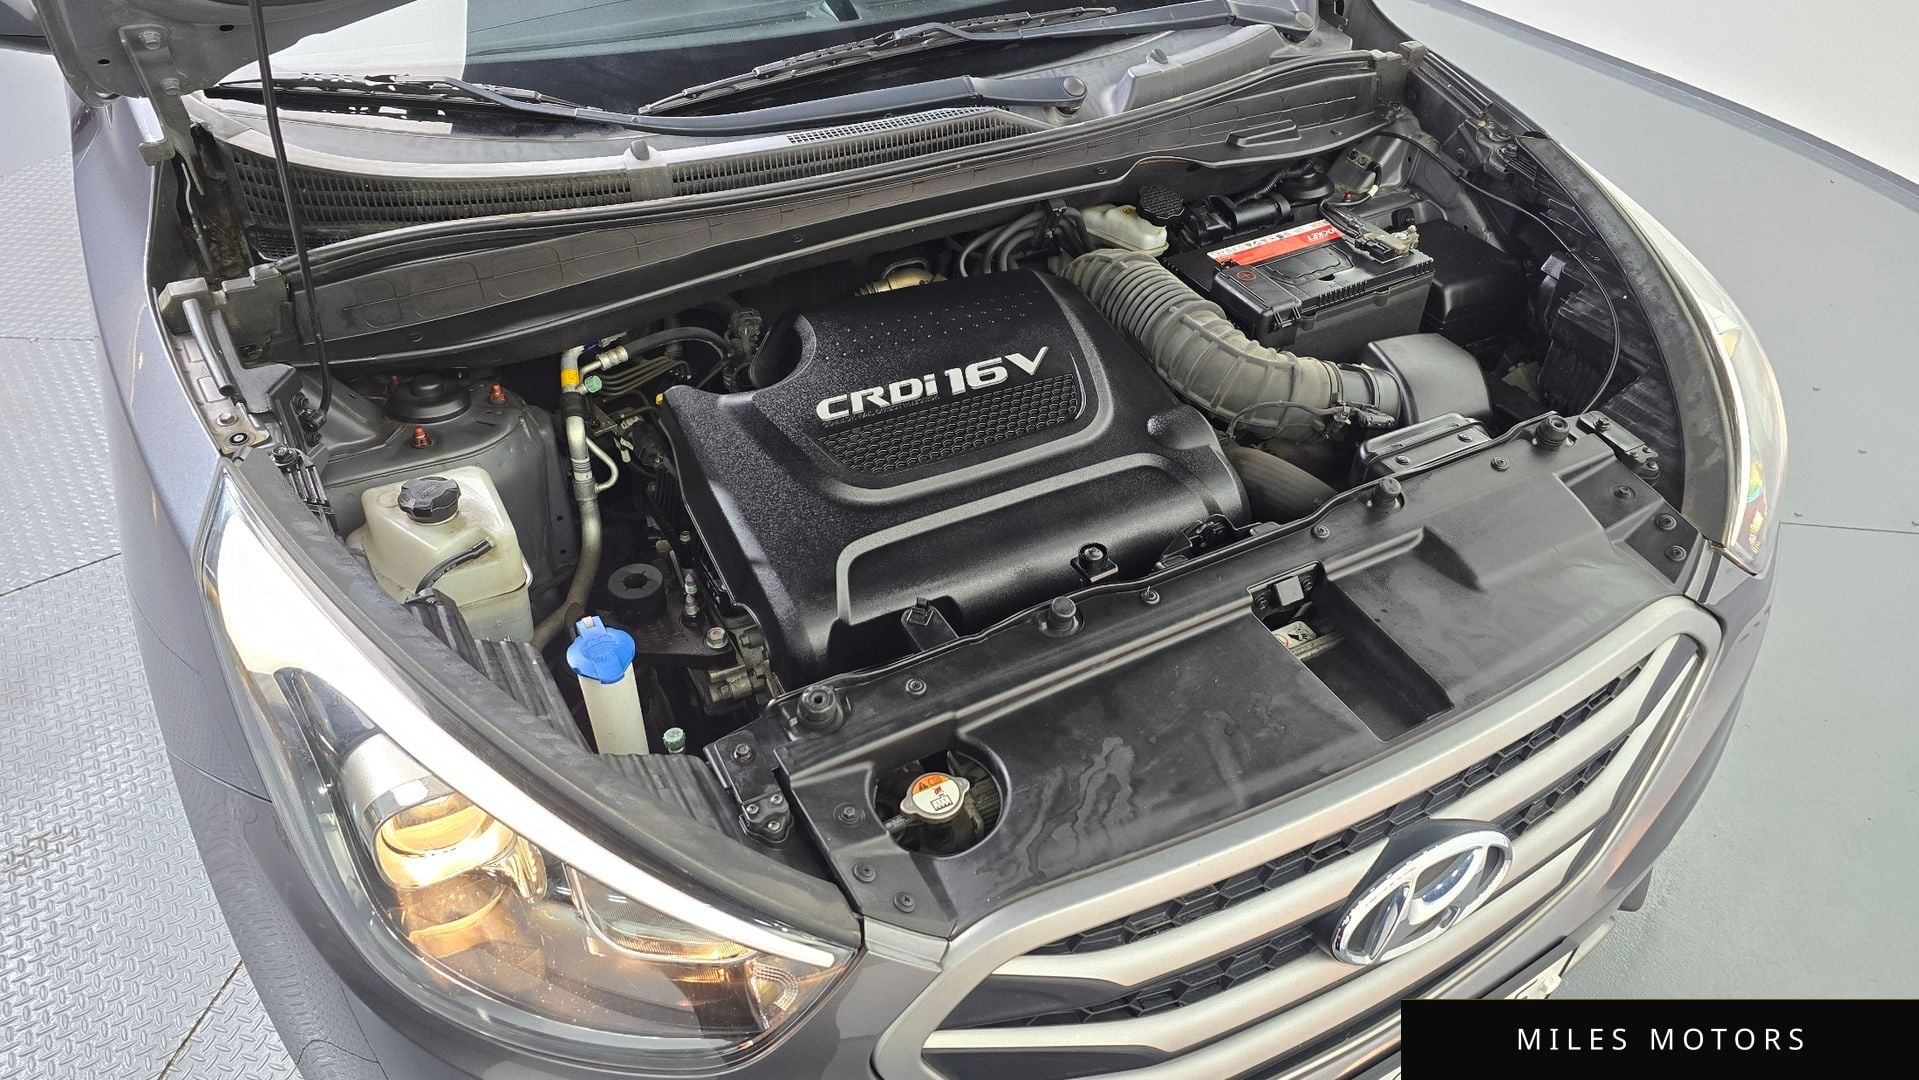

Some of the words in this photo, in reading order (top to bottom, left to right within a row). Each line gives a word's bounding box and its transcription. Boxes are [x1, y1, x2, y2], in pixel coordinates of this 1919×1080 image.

[1306, 227, 1338, 241] OCKET
[816, 373, 938, 421] CRDi
[944, 346, 1049, 395] 16V
